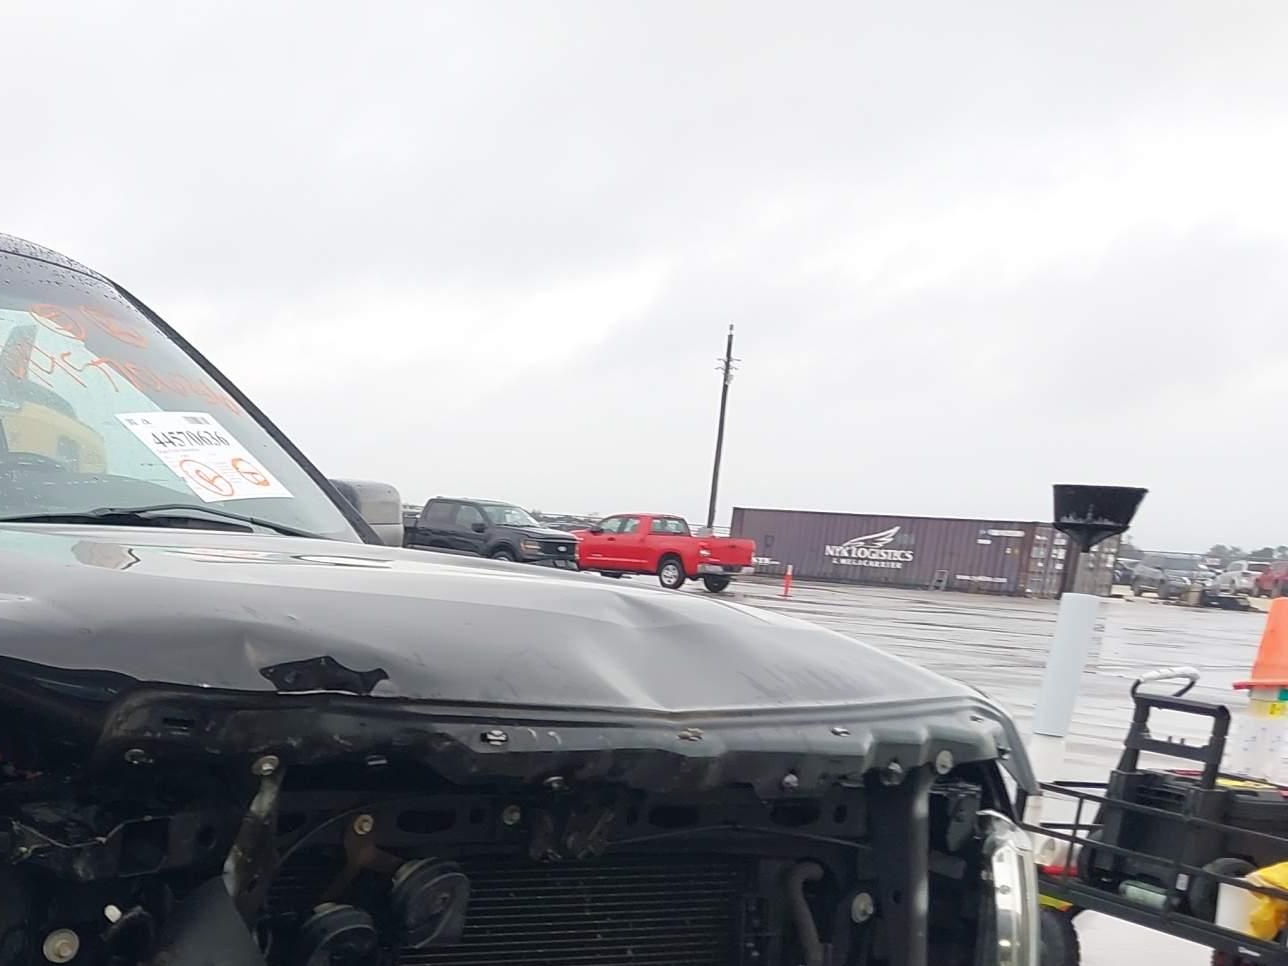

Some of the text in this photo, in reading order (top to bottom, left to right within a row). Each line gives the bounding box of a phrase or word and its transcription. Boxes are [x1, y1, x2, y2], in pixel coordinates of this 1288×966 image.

[151, 431, 231, 448] 44570636
[824, 544, 914, 562] NYK LOGISTICS
